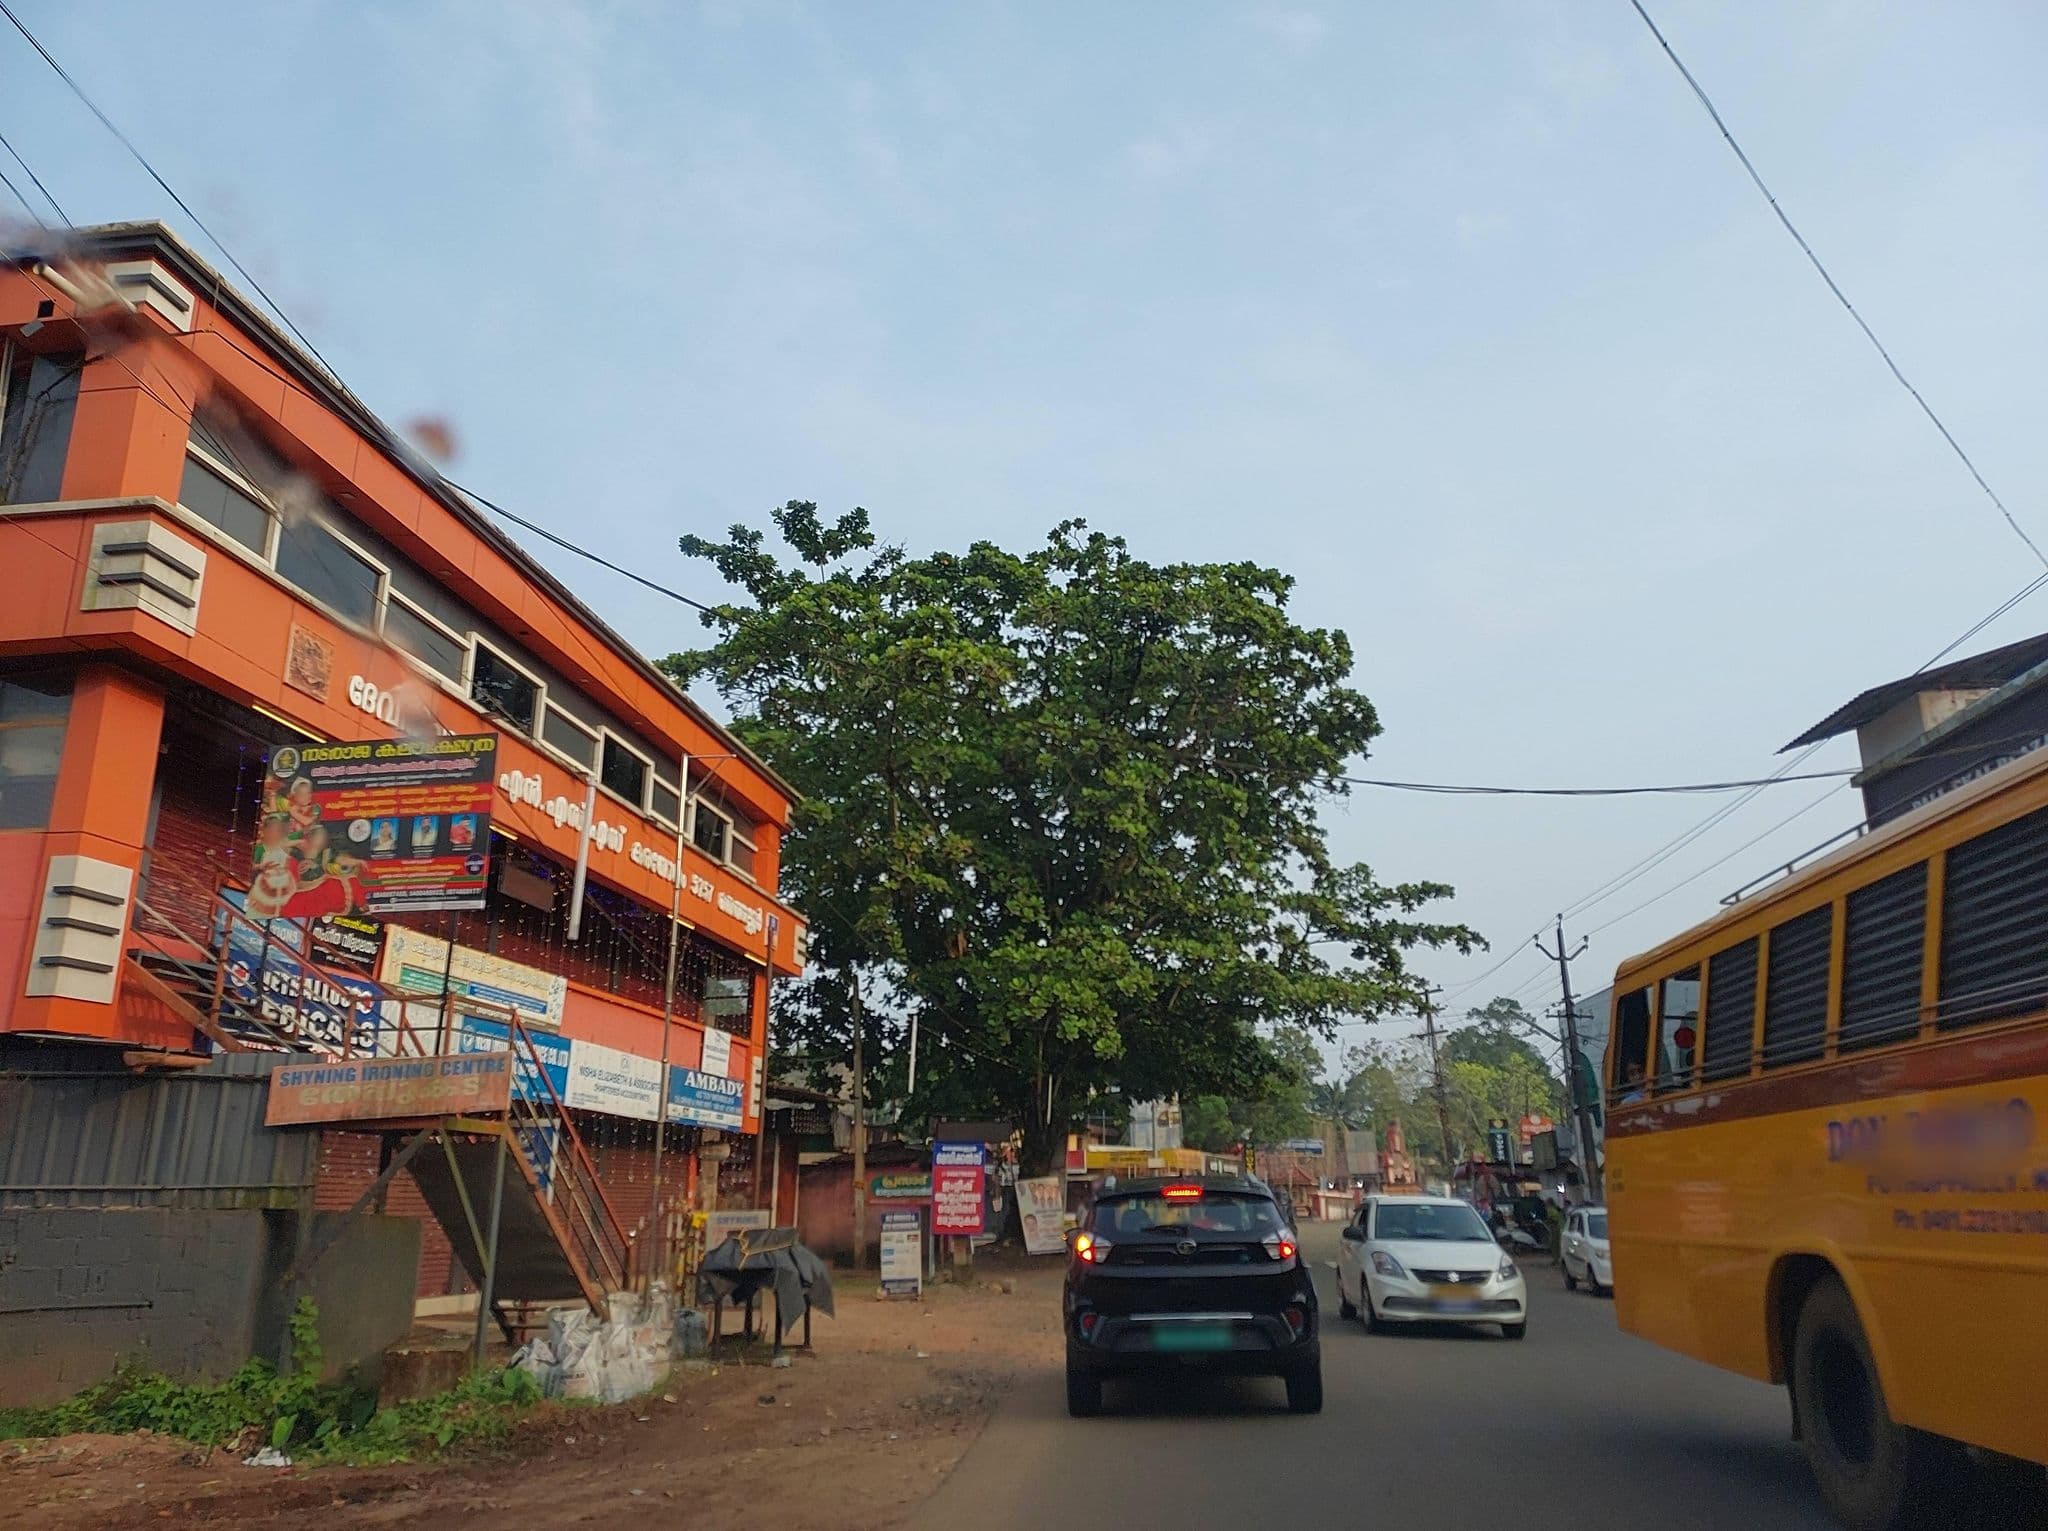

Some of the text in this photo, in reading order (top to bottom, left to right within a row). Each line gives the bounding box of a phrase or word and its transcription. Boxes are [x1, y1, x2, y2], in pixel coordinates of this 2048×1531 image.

[280, 1058, 506, 1088] SHYNING IRONING CENTRE
[684, 1071, 744, 1097] AMBADY
